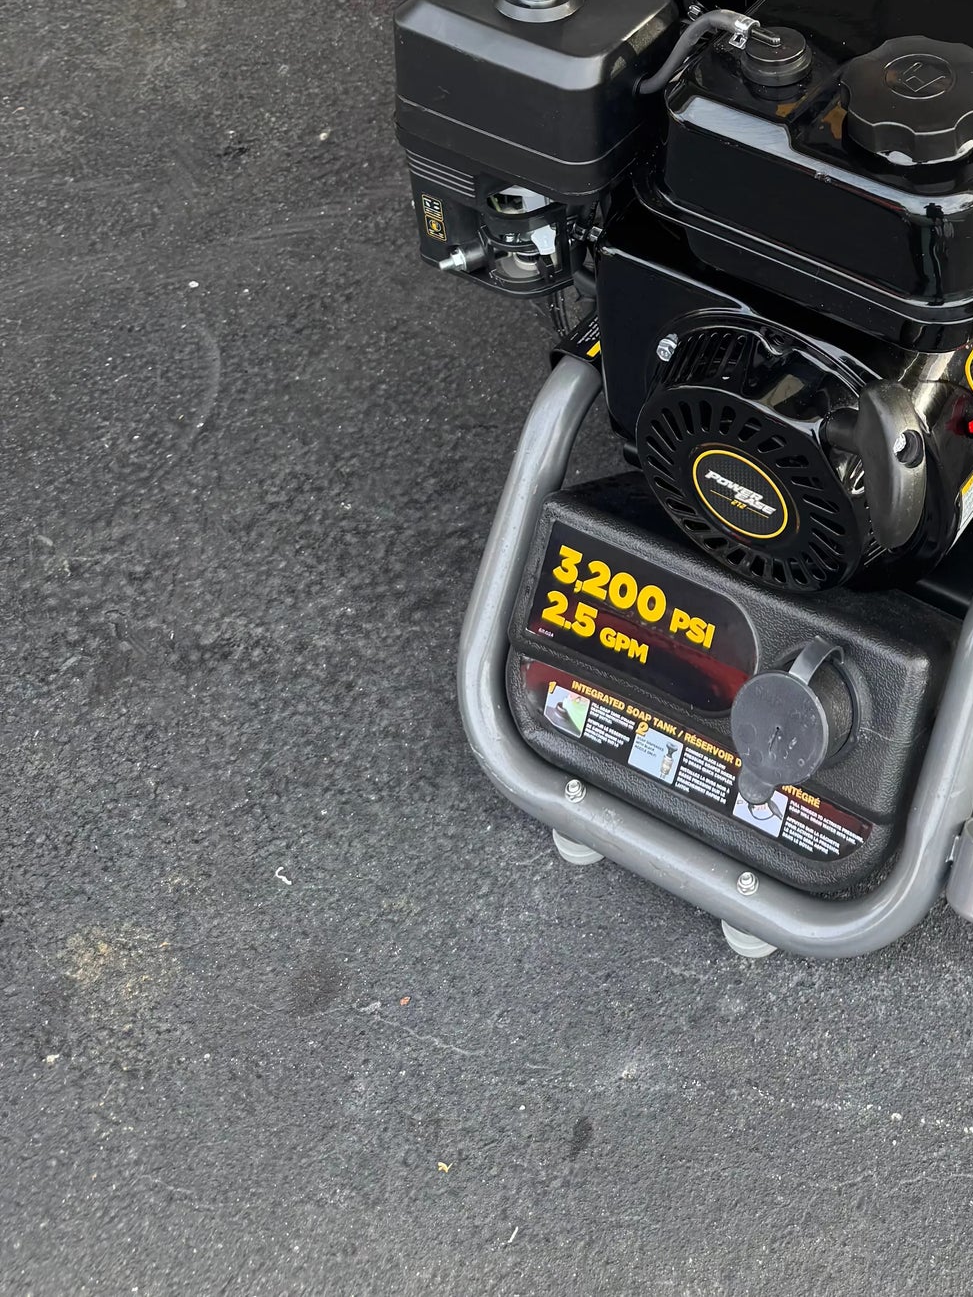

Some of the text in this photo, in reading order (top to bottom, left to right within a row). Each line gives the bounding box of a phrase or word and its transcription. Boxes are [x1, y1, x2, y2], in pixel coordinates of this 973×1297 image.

[704, 469, 764, 501] POWER
[552, 544, 716, 649] 3,200 PSI
[541, 590, 649, 664] 2.5 GPM
[548, 681, 557, 695] 1
[571, 680, 625, 711] INTEGRATED
[626, 705, 651, 722] SOAP
[652, 717, 676, 736] TANK
[685, 733, 734, 763] RÉSERVOIR
[635, 721, 650, 736] 2
